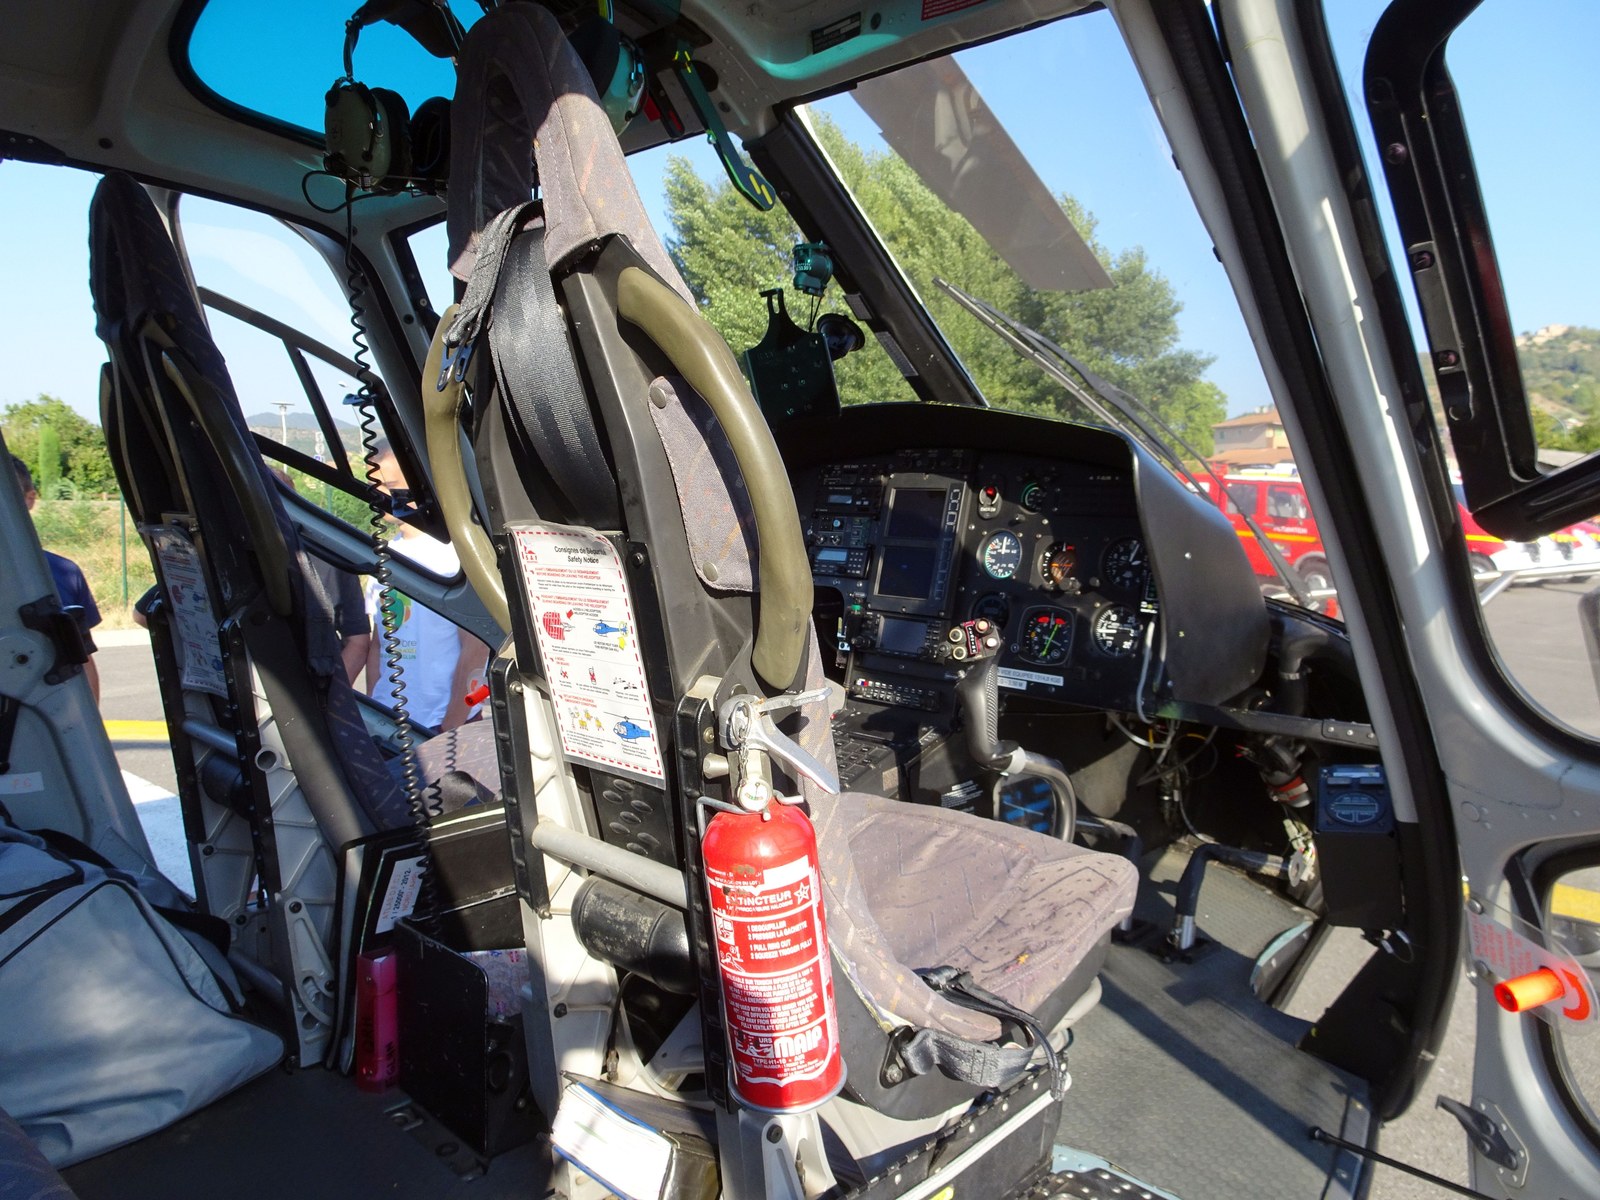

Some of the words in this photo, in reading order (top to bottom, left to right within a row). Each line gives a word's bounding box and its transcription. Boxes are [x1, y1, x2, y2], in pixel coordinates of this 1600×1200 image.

[567, 556, 582, 564] Safety
[583, 556, 599, 564] Notice
[776, 930, 783, 938] LA
[774, 1026, 822, 1058] MAIP
